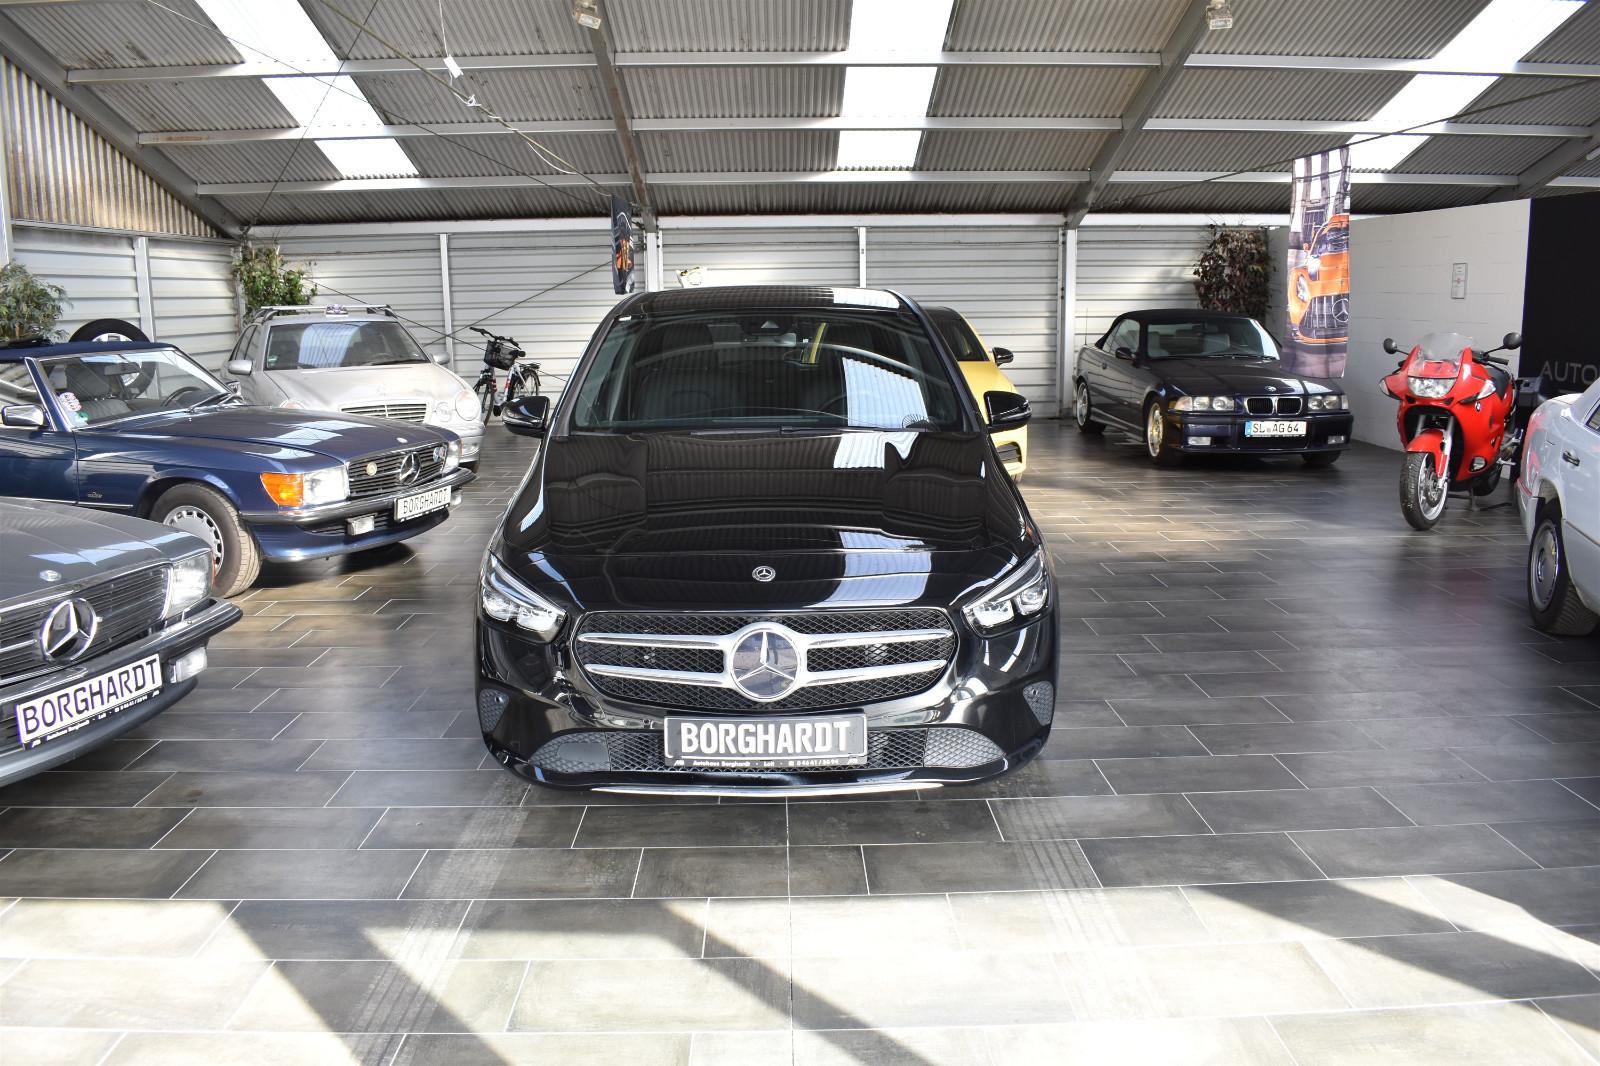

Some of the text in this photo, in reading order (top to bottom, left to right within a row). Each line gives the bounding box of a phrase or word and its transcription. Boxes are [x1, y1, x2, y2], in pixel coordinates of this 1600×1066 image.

[1287, 423, 1299, 433] 64
[22, 658, 157, 735] BORGHARDT
[680, 721, 851, 754] BORGHARDT
